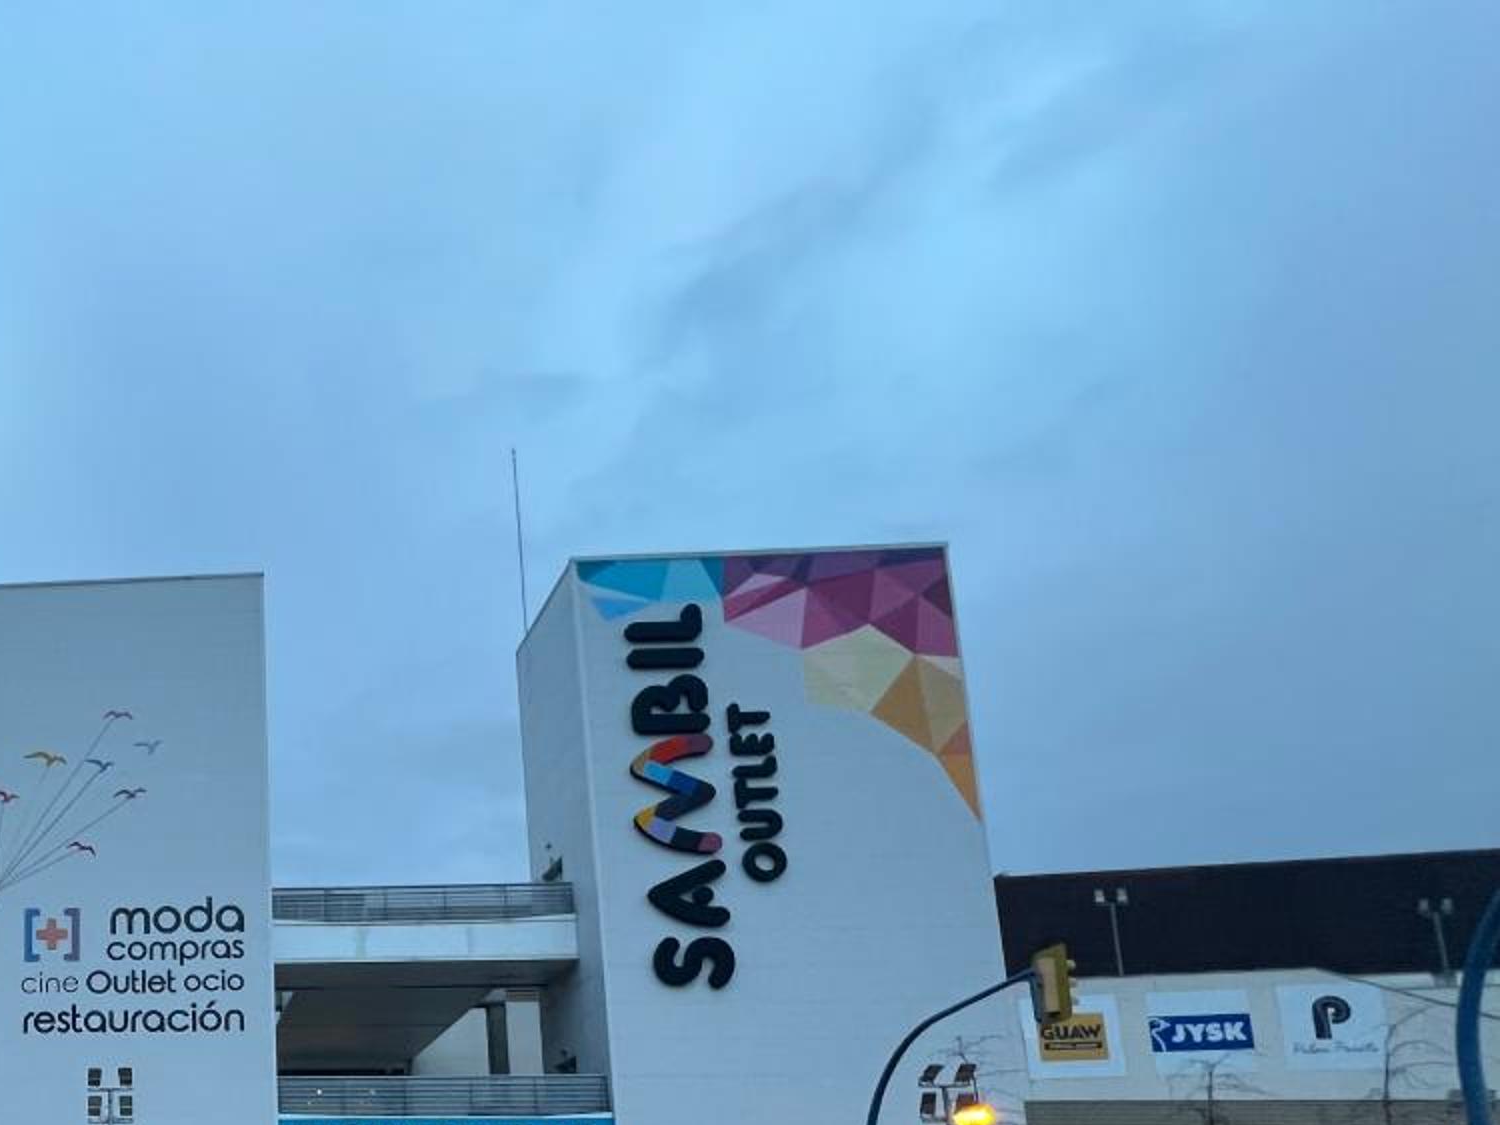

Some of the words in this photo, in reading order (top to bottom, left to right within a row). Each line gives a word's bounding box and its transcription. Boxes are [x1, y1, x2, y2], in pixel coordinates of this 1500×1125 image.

[623, 603, 736, 990] SAMBIL
[726, 702, 788, 884] OUTLET
[109, 896, 245, 935] moda
[106, 939, 245, 966] compras
[21, 971, 79, 993] cine
[86, 970, 177, 994] Outlet
[183, 969, 245, 992] ocio
[23, 1001, 245, 1034] restauración
[1041, 1024, 1101, 1040] GUAW
[1171, 1021, 1247, 1043] JYSK
